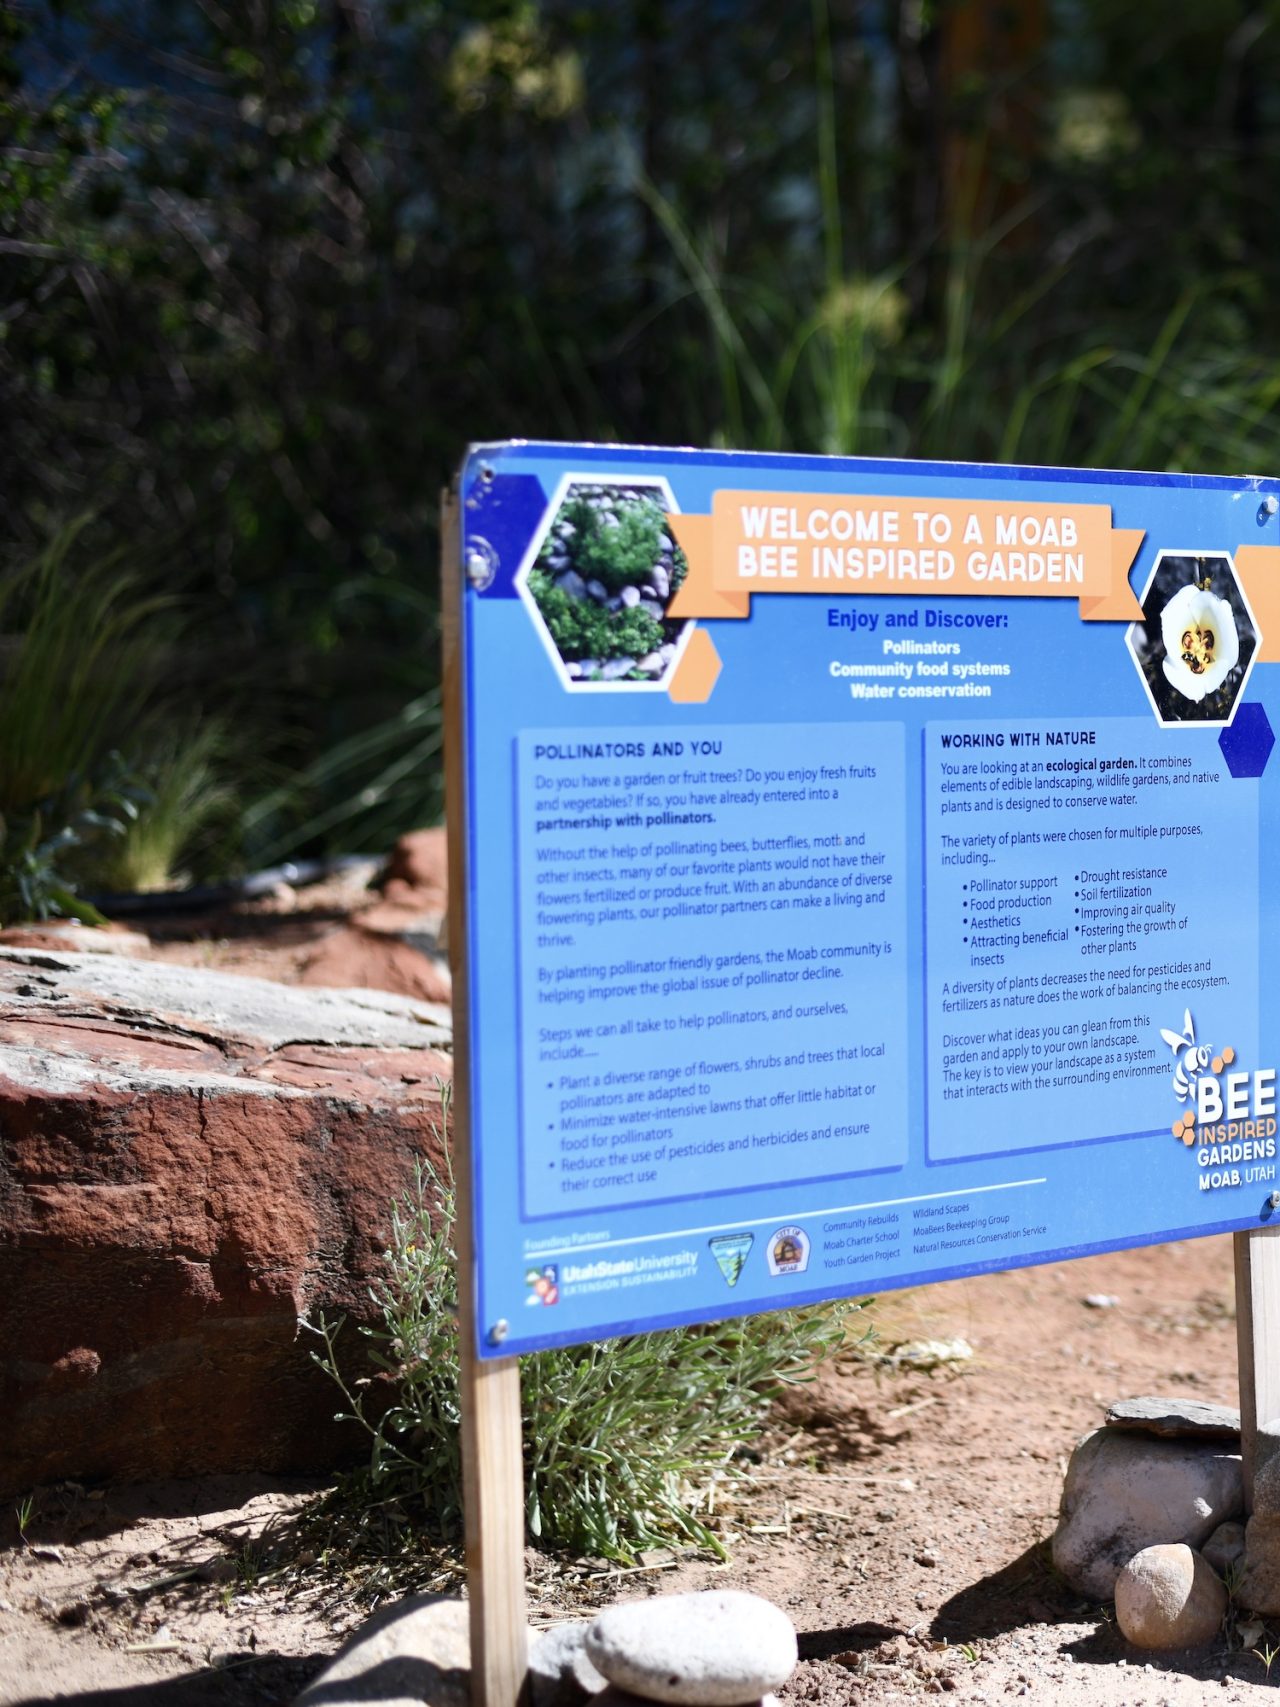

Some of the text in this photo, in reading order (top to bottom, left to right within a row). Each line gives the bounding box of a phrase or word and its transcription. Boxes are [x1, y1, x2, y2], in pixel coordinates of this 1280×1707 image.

[740, 506, 1077, 546] WELCOME TO A MOAB
[738, 545, 1084, 583] BEE INSPIRED GARDEN
[827, 609, 1008, 631] Enjoy and Discover:
[882, 639, 960, 655] Pollinators
[829, 661, 1010, 680] Community food systems
[850, 681, 991, 699] Water conservation
[534, 741, 722, 760] POLLINATORS AND YOU
[941, 731, 1095, 749] WORKING WITH NATURE
[940, 755, 1192, 776] You are looking at an ecological garden. It combines
[940, 770, 1219, 793] elements of edible landscaping, wildlife gardens, and native
[941, 792, 1138, 815] plants and is designed to conserve water.
[535, 814, 612, 833] partnership
[615, 813, 643, 827] with
[940, 824, 1204, 848] The variety of plants were chosen for multiple purposes,
[969, 876, 1058, 893] Pollinator support
[1080, 867, 1167, 885] Drought resistance
[969, 895, 1051, 913] Food production
[1080, 885, 1152, 902] Soil fertilization
[969, 915, 1021, 930] Aesthetics
[1080, 901, 1176, 922] Improving air quality
[1080, 917, 1188, 938] Fostering the growth of
[969, 929, 1068, 949] Attracting beneficial
[1080, 939, 1136, 956] other plants
[555, 965, 606, 984] planting
[609, 960, 667, 979] pollinator
[668, 956, 713, 972] friendly
[765, 950, 784, 964] the
[786, 947, 818, 962] Moab
[820, 942, 881, 960] community
[970, 953, 1004, 967] insects
[942, 1015, 1150, 1048] Discover what ideas you can glean from this
[942, 1035, 1140, 1067] garden and apply to your own landscape.
[942, 1048, 1155, 1083] The key is to view your landscape as a system
[942, 1061, 1174, 1100] that interacts with the surrounding environment.
[1198, 1069, 1276, 1124] BEE
[1198, 1118, 1277, 1145] INSPIRED
[1198, 1138, 1276, 1166] GARDENS
[1199, 1165, 1275, 1190] MOAB, UTAH
[822, 1211, 899, 1233] Community Rebuilds
[912, 1203, 969, 1219] Wildland Scapes
[913, 1214, 1010, 1237] MoaBees Beekeeping Group
[823, 1229, 899, 1251] Moab Charter School
[913, 1226, 1047, 1255] Natural Resources Conservation Service
[823, 1245, 900, 1269] Youth Garden Project
